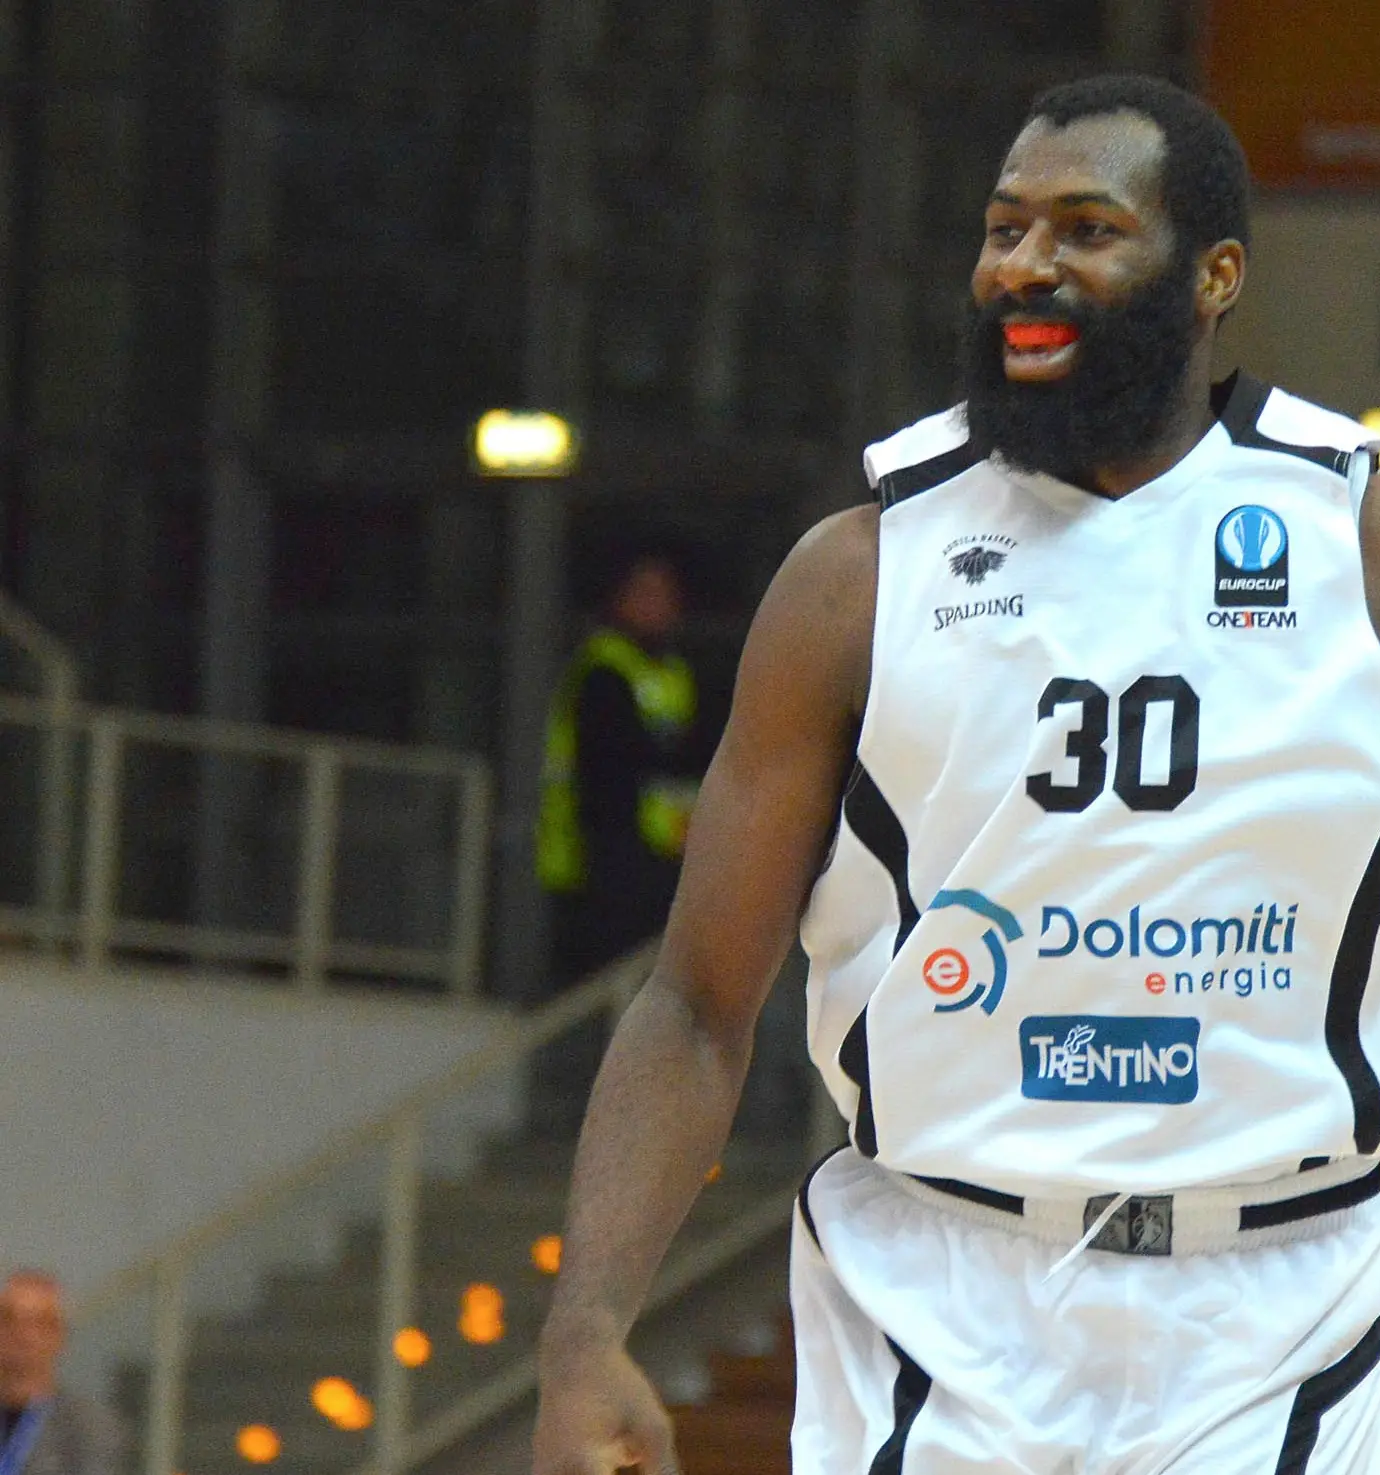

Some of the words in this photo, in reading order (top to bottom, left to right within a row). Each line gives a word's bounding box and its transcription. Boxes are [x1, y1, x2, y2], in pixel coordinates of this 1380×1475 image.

[1218, 578, 1286, 591] EUROCUP
[934, 593, 1024, 632] SPALDING
[1026, 674, 1200, 813] 30
[1038, 902, 1300, 959] Dolomiti
[1145, 962, 1292, 997] energia
[1029, 1034, 1194, 1088] TRENTINO
